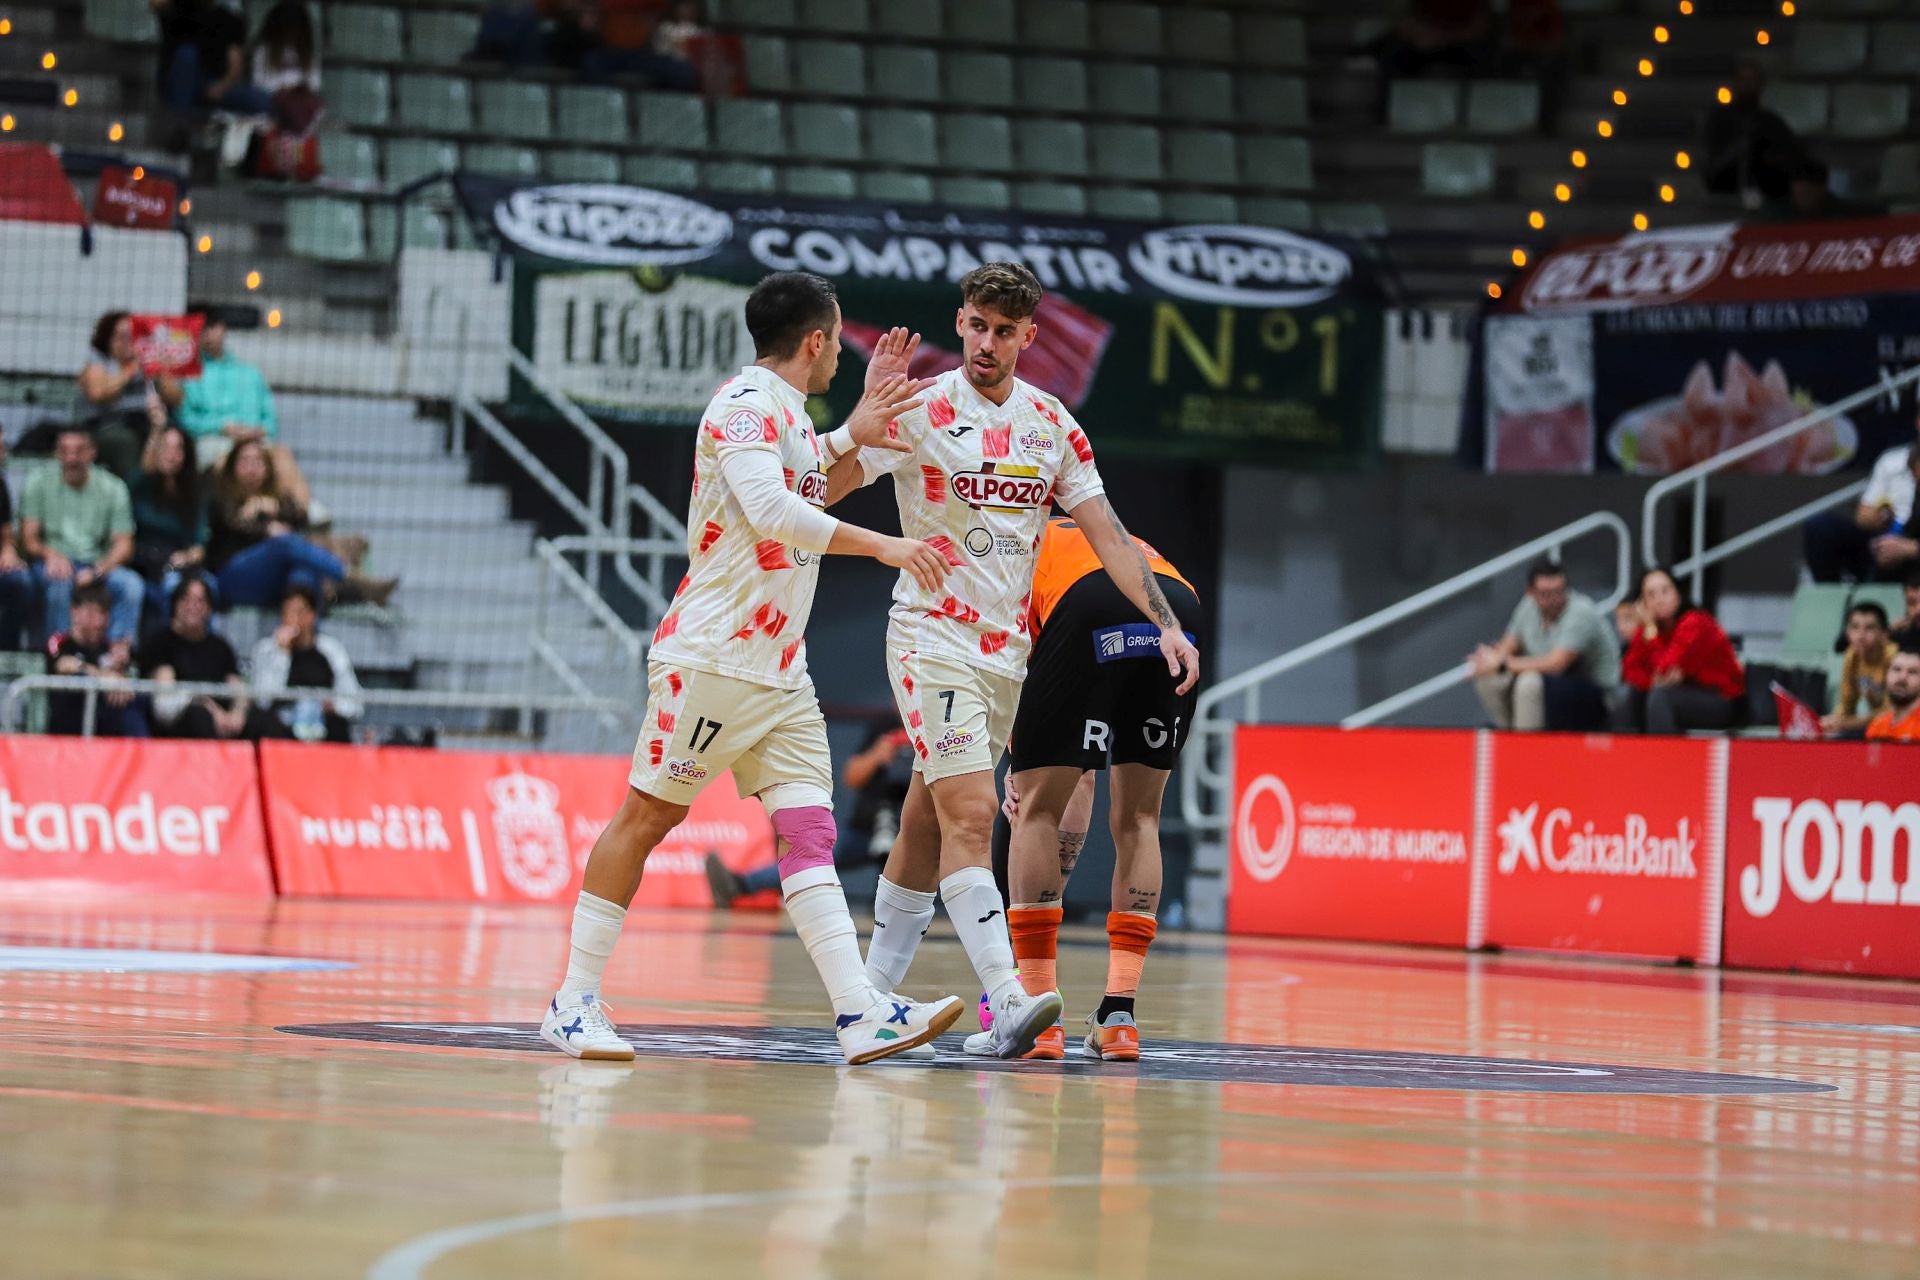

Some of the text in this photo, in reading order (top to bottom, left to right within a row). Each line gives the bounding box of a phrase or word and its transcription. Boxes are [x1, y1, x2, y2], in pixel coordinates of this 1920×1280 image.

[749, 227, 1131, 294] COMPARTIR
[562, 297, 738, 374] LEGADO
[1127, 636, 1161, 647] GRUPO
[939, 690, 954, 723] 7
[688, 716, 722, 753] 17
[941, 748, 967, 758] FUTSAL
[667, 776, 694, 786] FUTSAL
[0, 787, 230, 856] tander
[301, 815, 451, 852] MURCIA
[1540, 807, 1697, 878] CaixaBank
